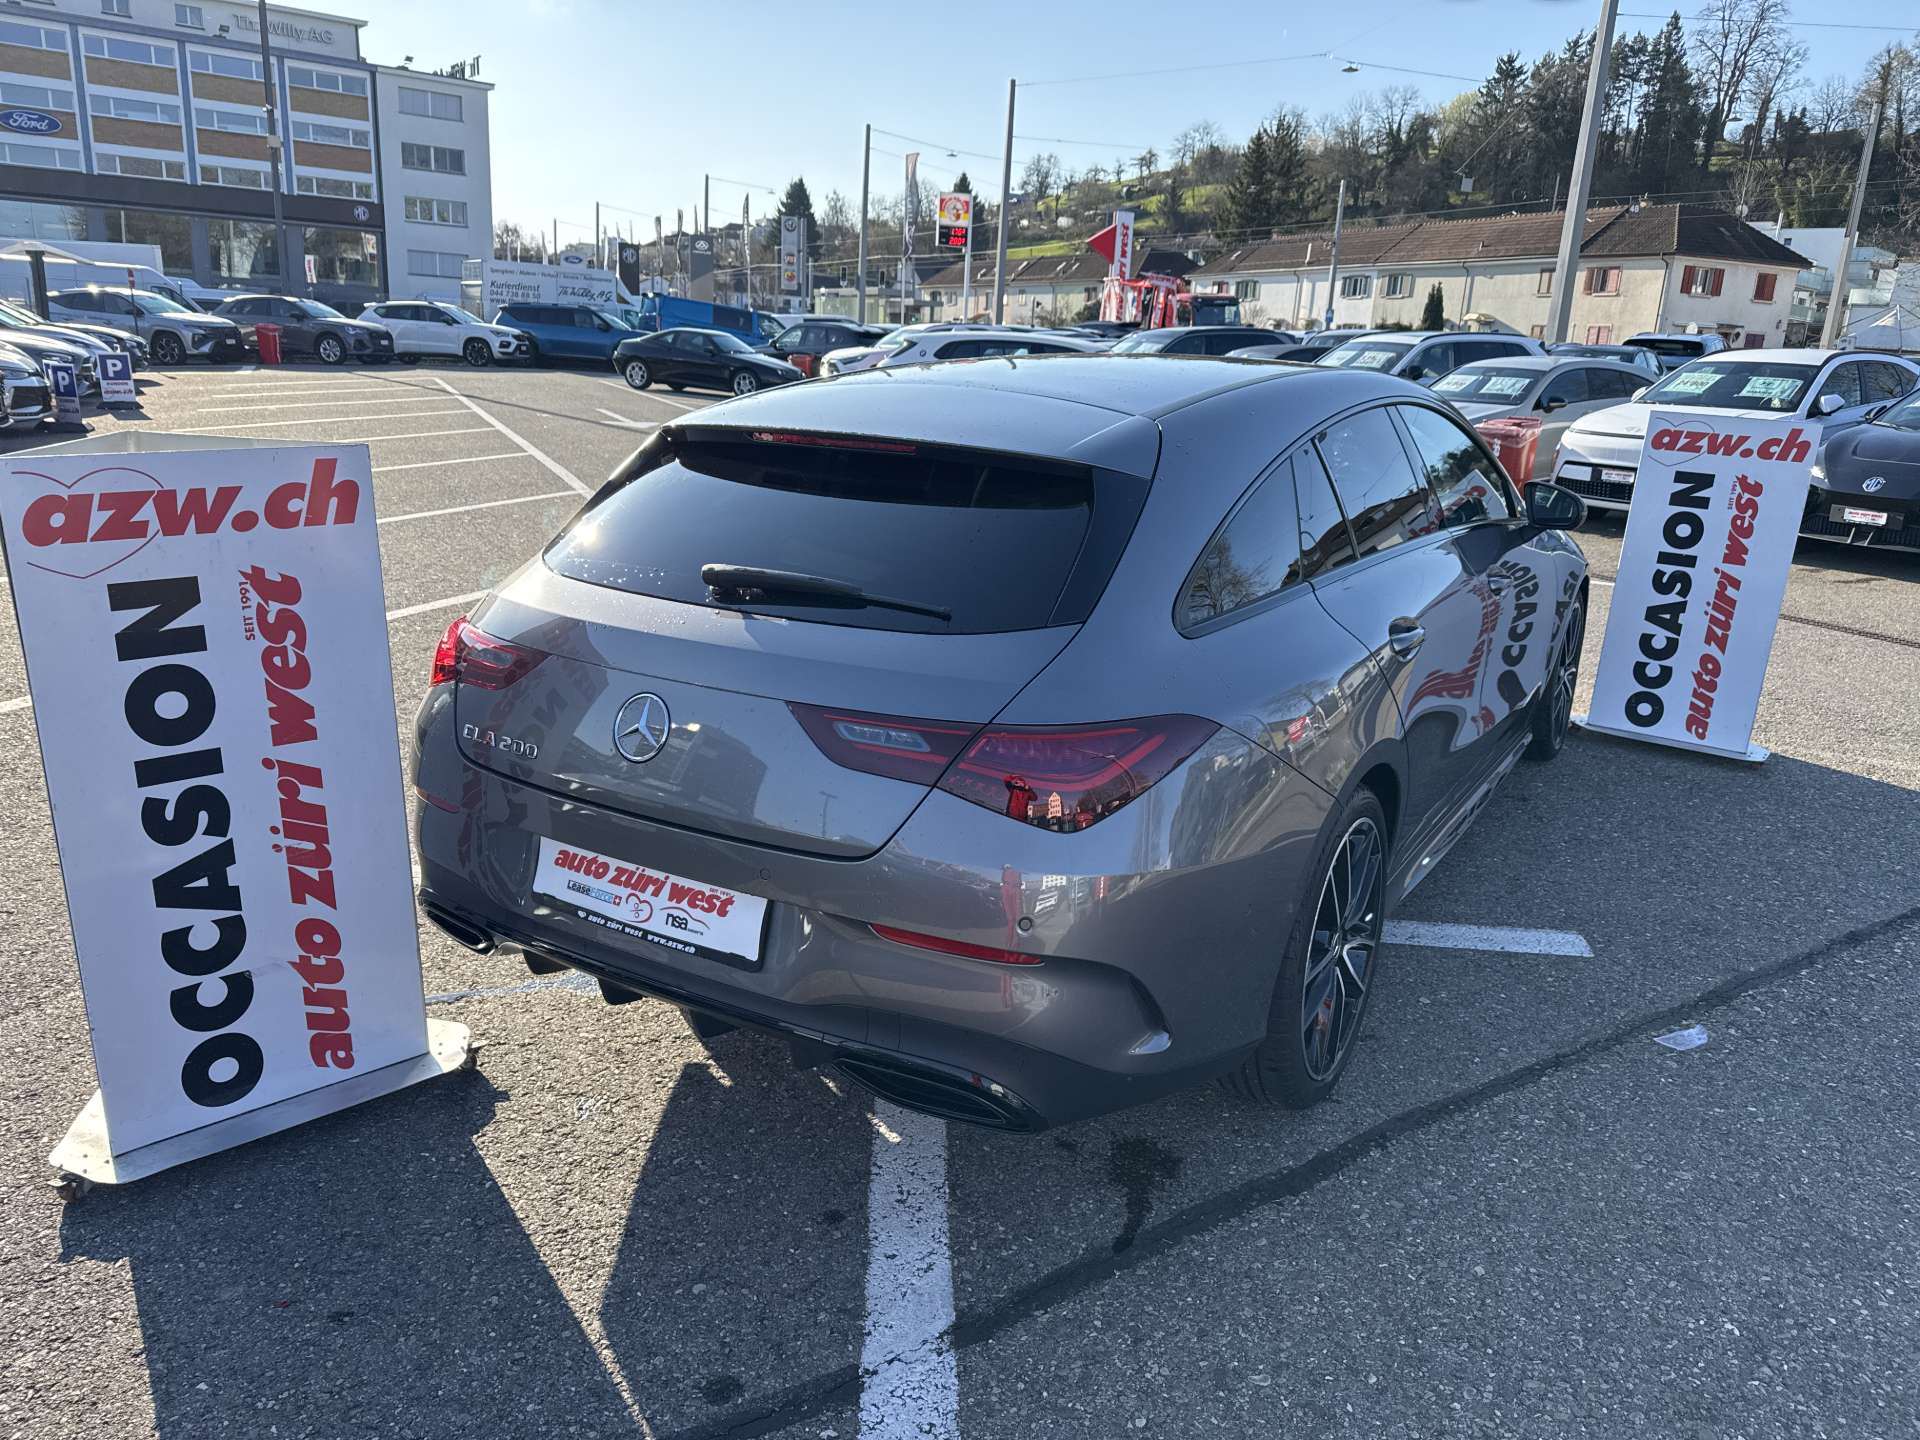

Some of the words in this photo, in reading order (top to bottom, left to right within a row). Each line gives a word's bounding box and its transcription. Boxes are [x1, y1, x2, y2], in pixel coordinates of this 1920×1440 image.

[308, 27, 334, 44] AG
[9, 112, 48, 130] Ford
[623, 248, 637, 264] MG
[490, 280, 541, 292] Kurierdienst
[596, 291, 613, 302] AG
[57, 371, 70, 392] P
[106, 359, 121, 378] P
[1651, 428, 1812, 463] azw.ch
[1863, 476, 1886, 493] MG
[22, 458, 360, 547] azw.ch
[1722, 474, 1763, 566] west
[240, 581, 251, 611] 1991
[1624, 470, 1715, 728] OCCASION
[1704, 567, 1742, 656] züri
[244, 614, 255, 640] SEIT
[239, 564, 318, 747] west
[1685, 653, 1722, 741] auto
[463, 724, 496, 747] CLA
[499, 736, 538, 759] 200
[107, 575, 264, 1107] OCCASION
[261, 756, 337, 911] züri
[554, 850, 610, 877] auto
[608, 866, 669, 897] züri
[668, 881, 735, 917] west
[588, 914, 607, 926] auto
[624, 925, 644, 938] west
[647, 933, 696, 954] www.azw.ch
[665, 913, 688, 931] nsa
[287, 917, 355, 1070] auto
